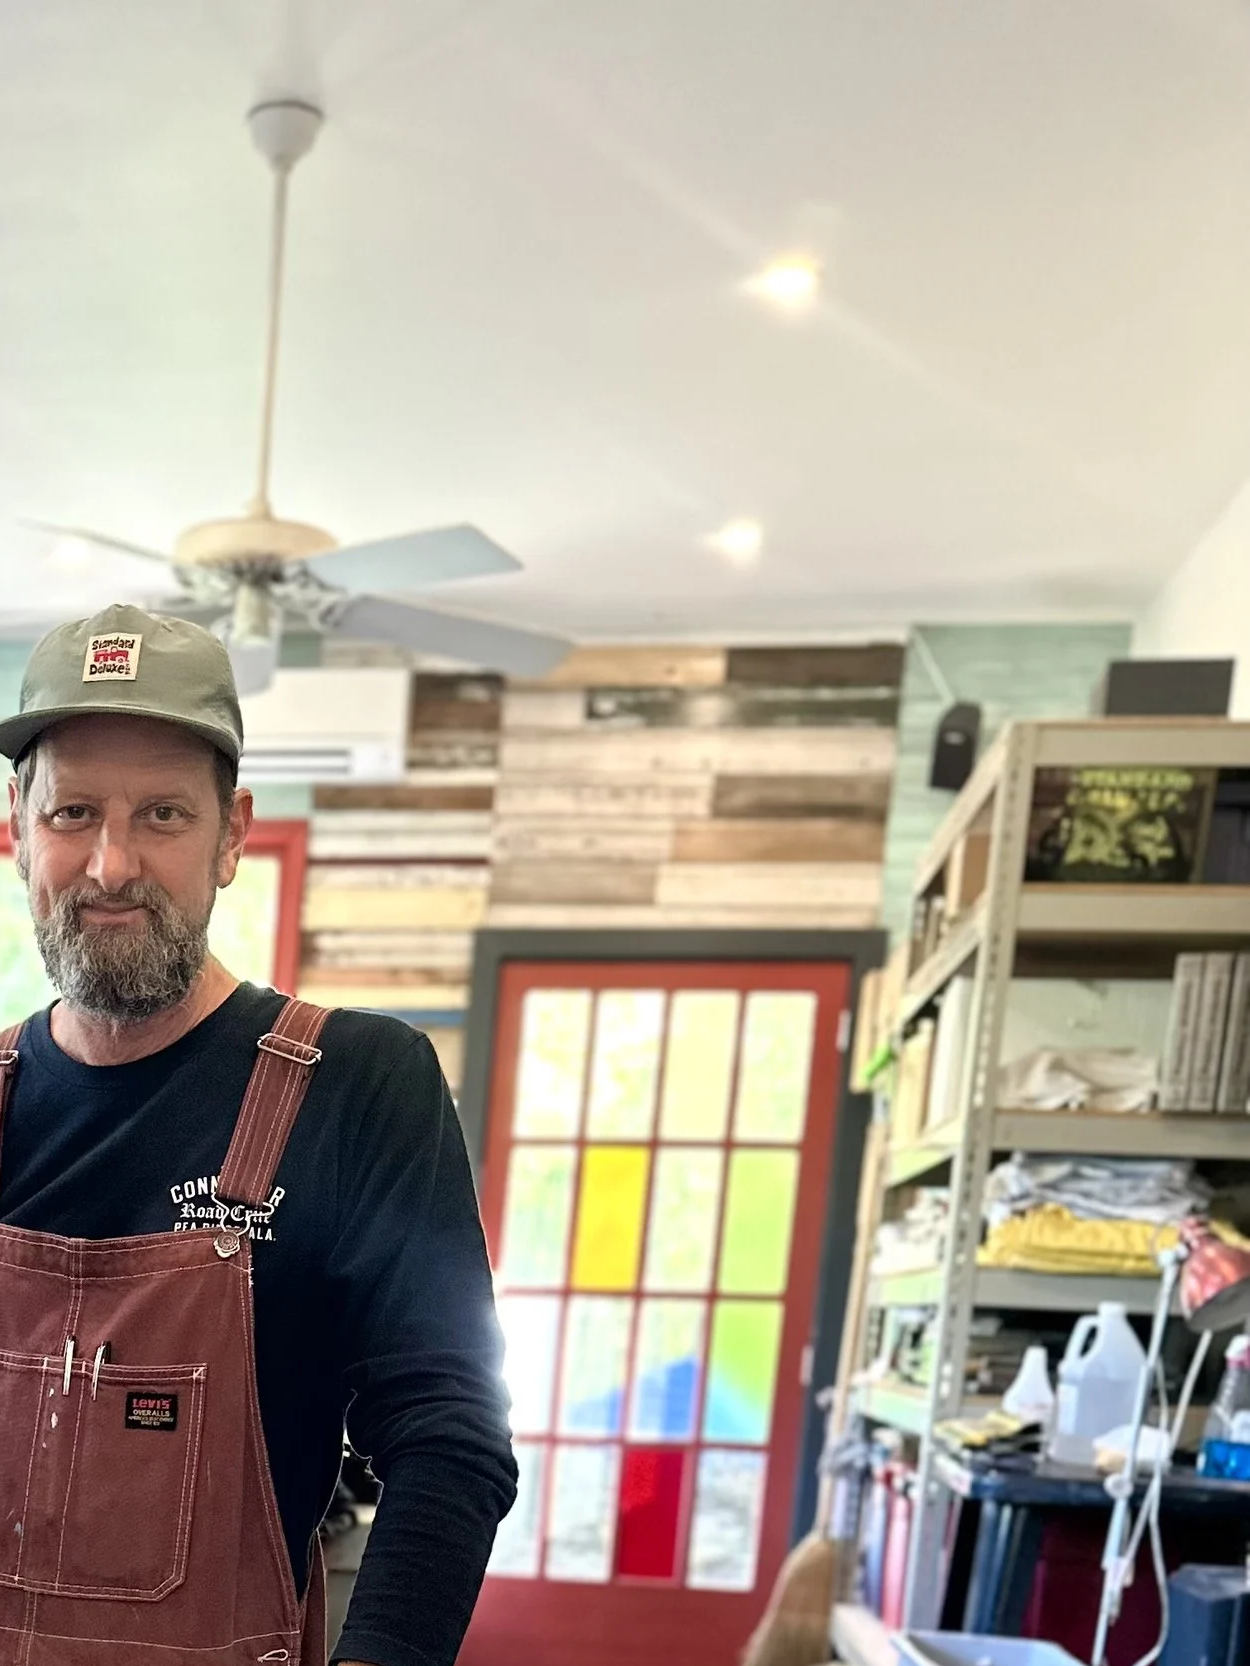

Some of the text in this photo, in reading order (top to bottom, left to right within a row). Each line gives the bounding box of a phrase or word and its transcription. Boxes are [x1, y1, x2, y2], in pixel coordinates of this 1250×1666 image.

[92, 636, 135, 650] Standard
[89, 663, 125, 675] Deluxe
[180, 1203, 225, 1219] Road
[133, 1409, 170, 1417] OVERALLS
